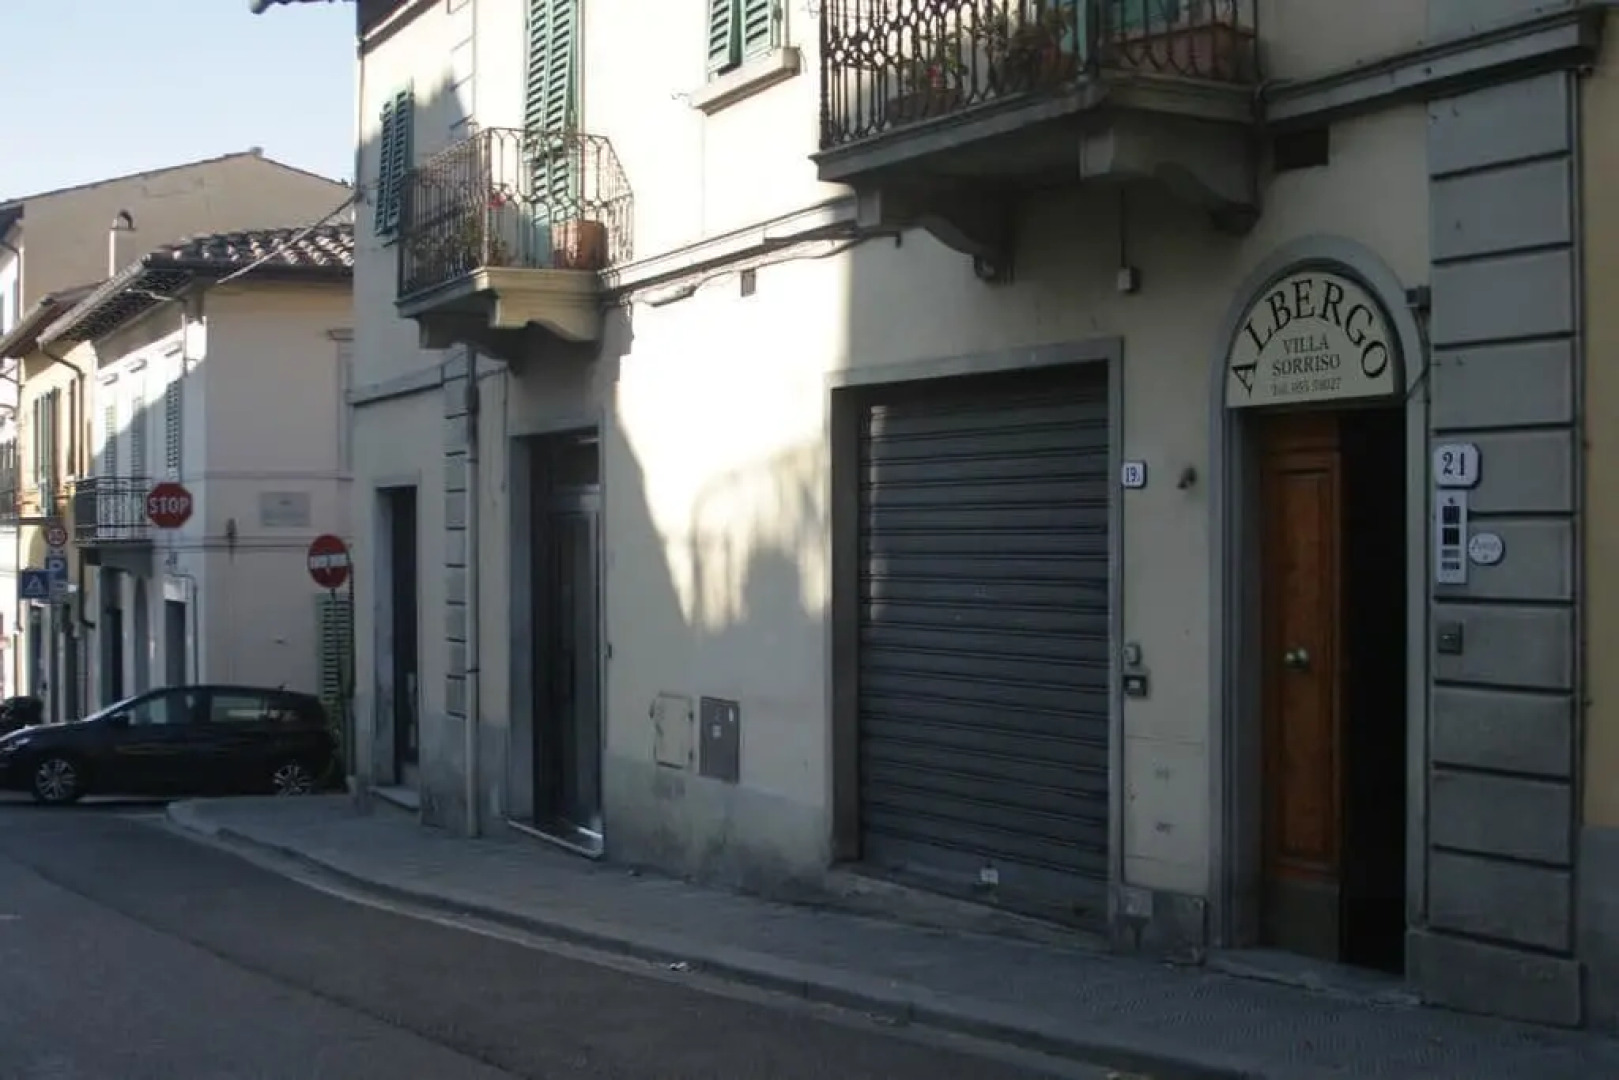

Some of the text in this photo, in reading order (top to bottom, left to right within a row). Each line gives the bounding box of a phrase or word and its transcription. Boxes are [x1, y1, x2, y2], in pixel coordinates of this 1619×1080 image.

[1231, 278, 1388, 398] ALBERGO
[1282, 333, 1329, 355] VILLA
[1272, 353, 1341, 377] SORRISO
[1442, 451, 1465, 476] 21
[149, 496, 189, 514] STOP
